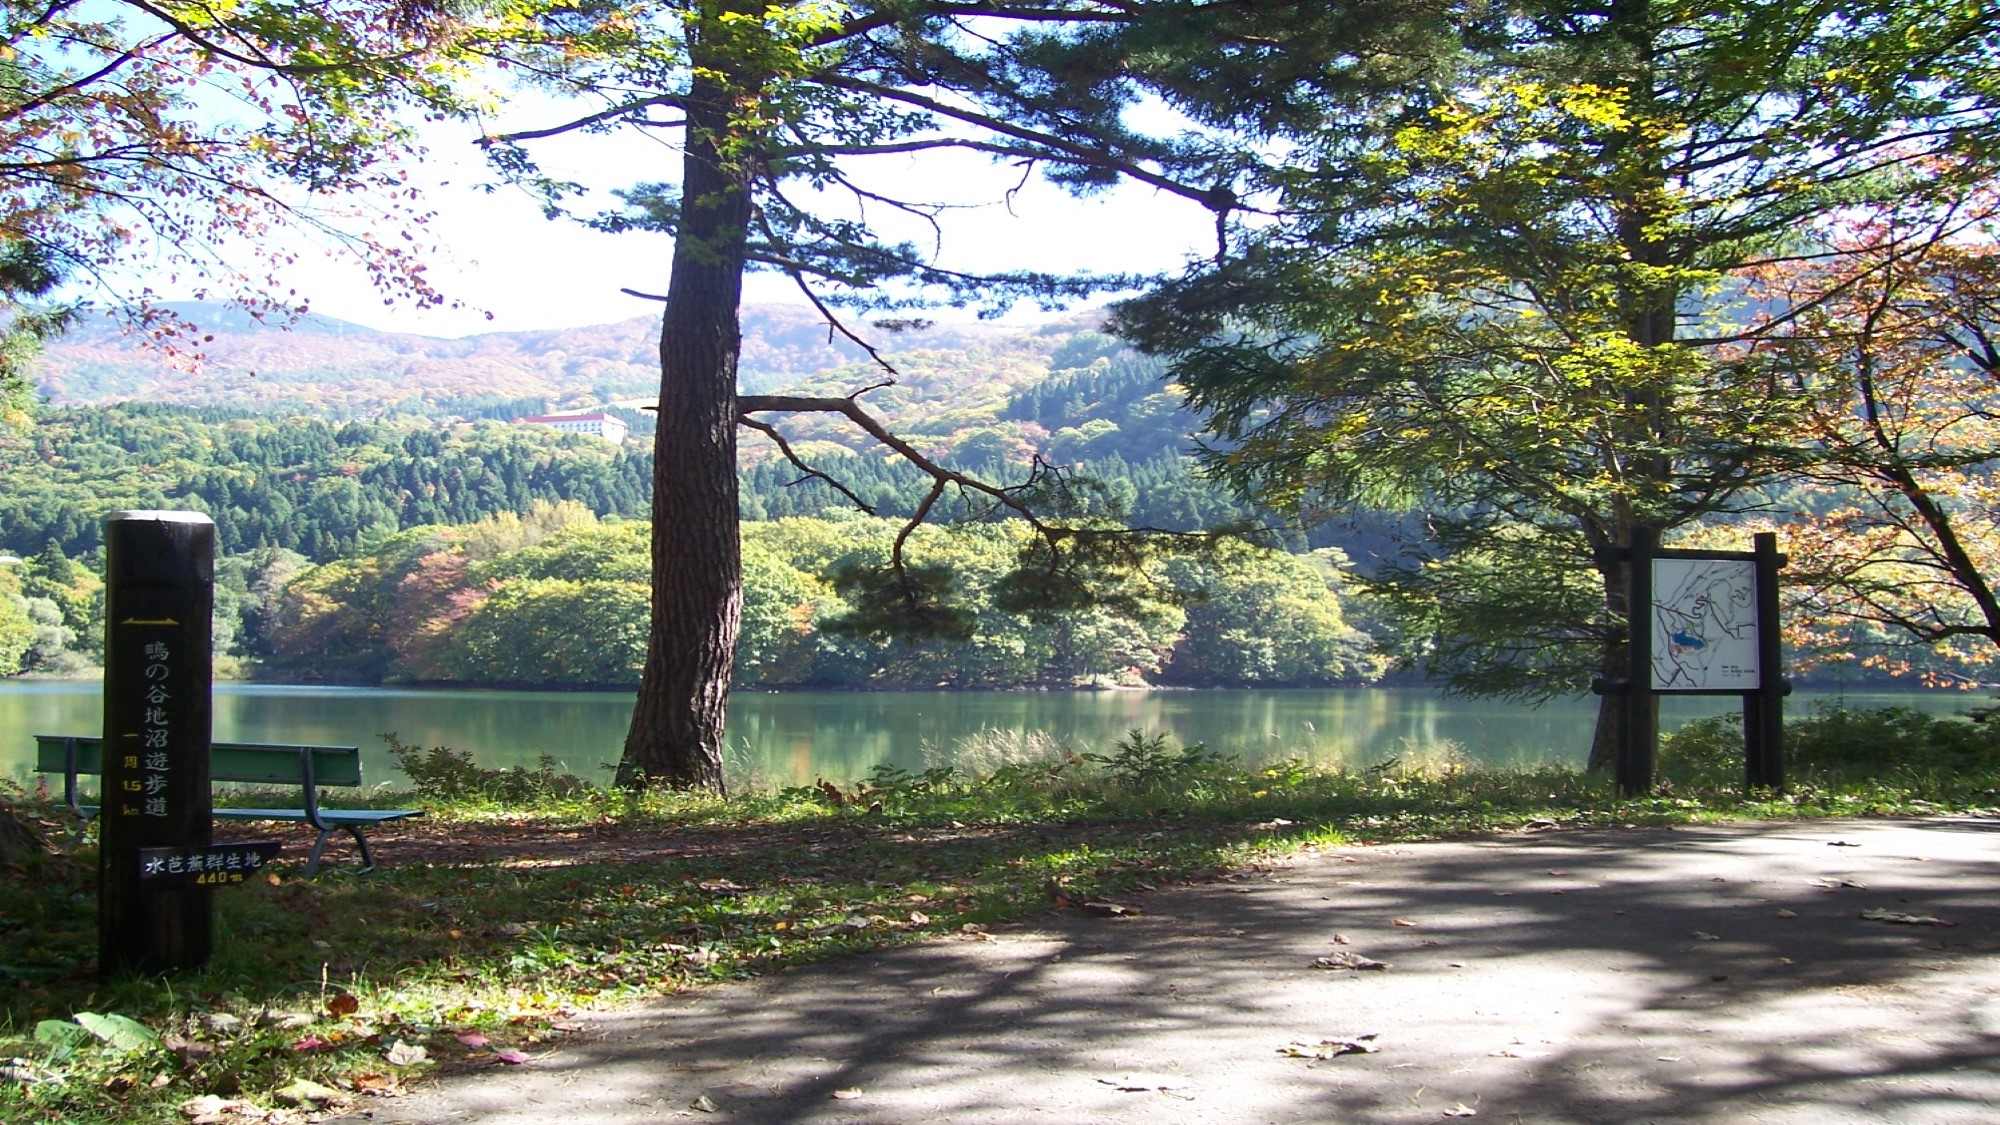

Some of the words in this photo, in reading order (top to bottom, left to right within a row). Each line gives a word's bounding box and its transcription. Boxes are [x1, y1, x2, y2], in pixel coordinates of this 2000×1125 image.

[145, 852, 262, 875] 水芭蕉群生地
